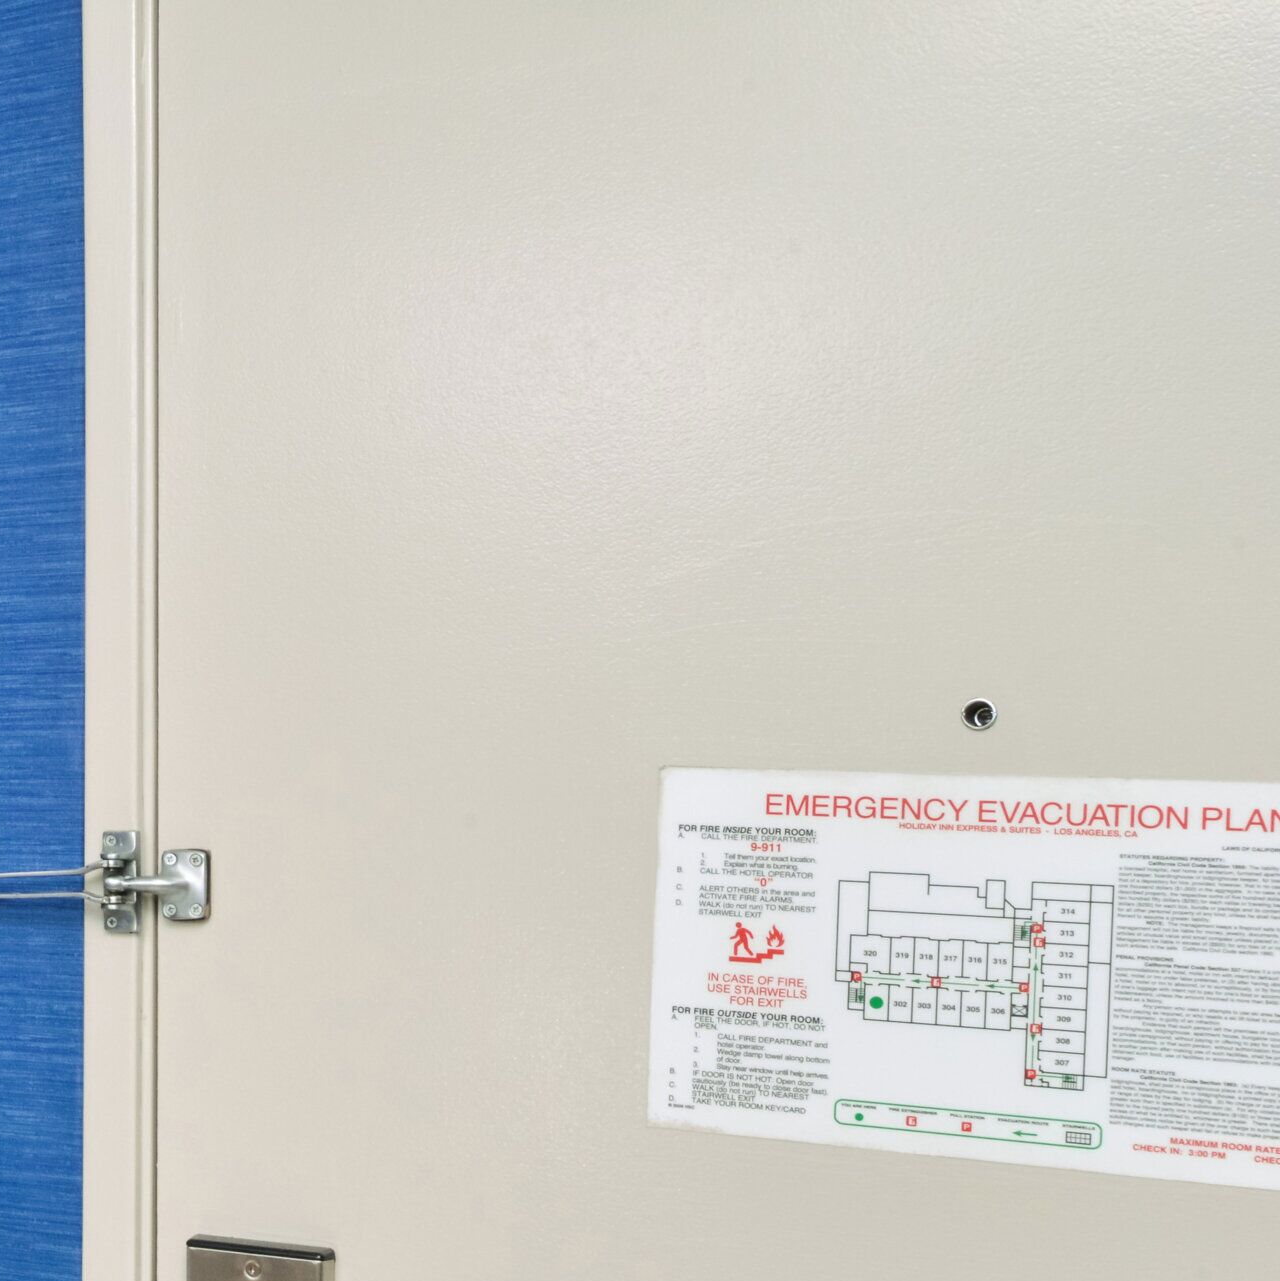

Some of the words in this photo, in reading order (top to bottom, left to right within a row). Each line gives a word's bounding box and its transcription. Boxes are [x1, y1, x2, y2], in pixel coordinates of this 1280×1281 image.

[765, 794, 968, 821] EMERGENCY
[978, 801, 1188, 829] EVACUATION
[723, 826, 752, 834] INSIDE
[899, 822, 936, 830] HOLIDAY
[957, 824, 998, 833] EXPRESS
[1009, 826, 1041, 834] SUITES
[1054, 828, 1072, 836] LOS
[1075, 829, 1121, 837] ANGELES,
[1125, 830, 1138, 838] CA
[751, 843, 781, 852] 9-911
[724, 861, 747, 869] Explain
[768, 871, 813, 879] OPERATOR
[699, 909, 742, 917] STAIRWELL
[708, 972, 719, 981] IN
[722, 973, 753, 984] CASE
[758, 976, 774, 985] OF
[778, 977, 807, 988] FIRE,
[1058, 972, 1072, 980] 311
[708, 984, 730, 993] USE
[734, 986, 807, 999] STAIRWELLS
[730, 996, 753, 1006] FOR
[758, 998, 784, 1008] EXIT
[893, 1000, 907, 1008] 302
[672, 1006, 691, 1014] FOR
[694, 1007, 714, 1016] FIRE
[717, 1009, 757, 1019] OUTSIDE
[761, 1012, 787, 1022] YOUR
[791, 1014, 824, 1024] ROOM:
[695, 1015, 714, 1023] FEEL
[717, 1033, 736, 1041] CALL
[758, 1036, 812, 1047] DEPARTMENT
[717, 1048, 741, 1058] Wedge
[743, 1050, 763, 1059] damp
[785, 1054, 804, 1063] along
[806, 1056, 830, 1064] bottom
[717, 1064, 730, 1072] Stay
[790, 1069, 804, 1077] help
[702, 1071, 724, 1079] DOOR
[776, 1078, 795, 1087] Open
[692, 1078, 726, 1087] cautiously
[729, 1080, 740, 1088] (be
[742, 1081, 762, 1091] ready
[773, 1083, 790, 1091] close
[812, 1086, 828, 1096] fast).
[716, 1086, 726, 1094] (do
[742, 1088, 756, 1096] run)
[759, 1089, 770, 1097] TO
[772, 1091, 809, 1100] NEAREST
[692, 1090, 735, 1100] STAIRWELL
[692, 1097, 712, 1105] TAKE
[714, 1099, 737, 1108] YOUR
[739, 1101, 763, 1110] ROOM
[765, 1103, 806, 1114] KEY/CARD
[1133, 1143, 1167, 1154] CHECK
[1189, 1149, 1208, 1157] 3:00
[1212, 1151, 1226, 1159] PM
[1170, 1137, 1218, 1148] MAXIMUM
[1221, 1142, 1252, 1152] ROOM
